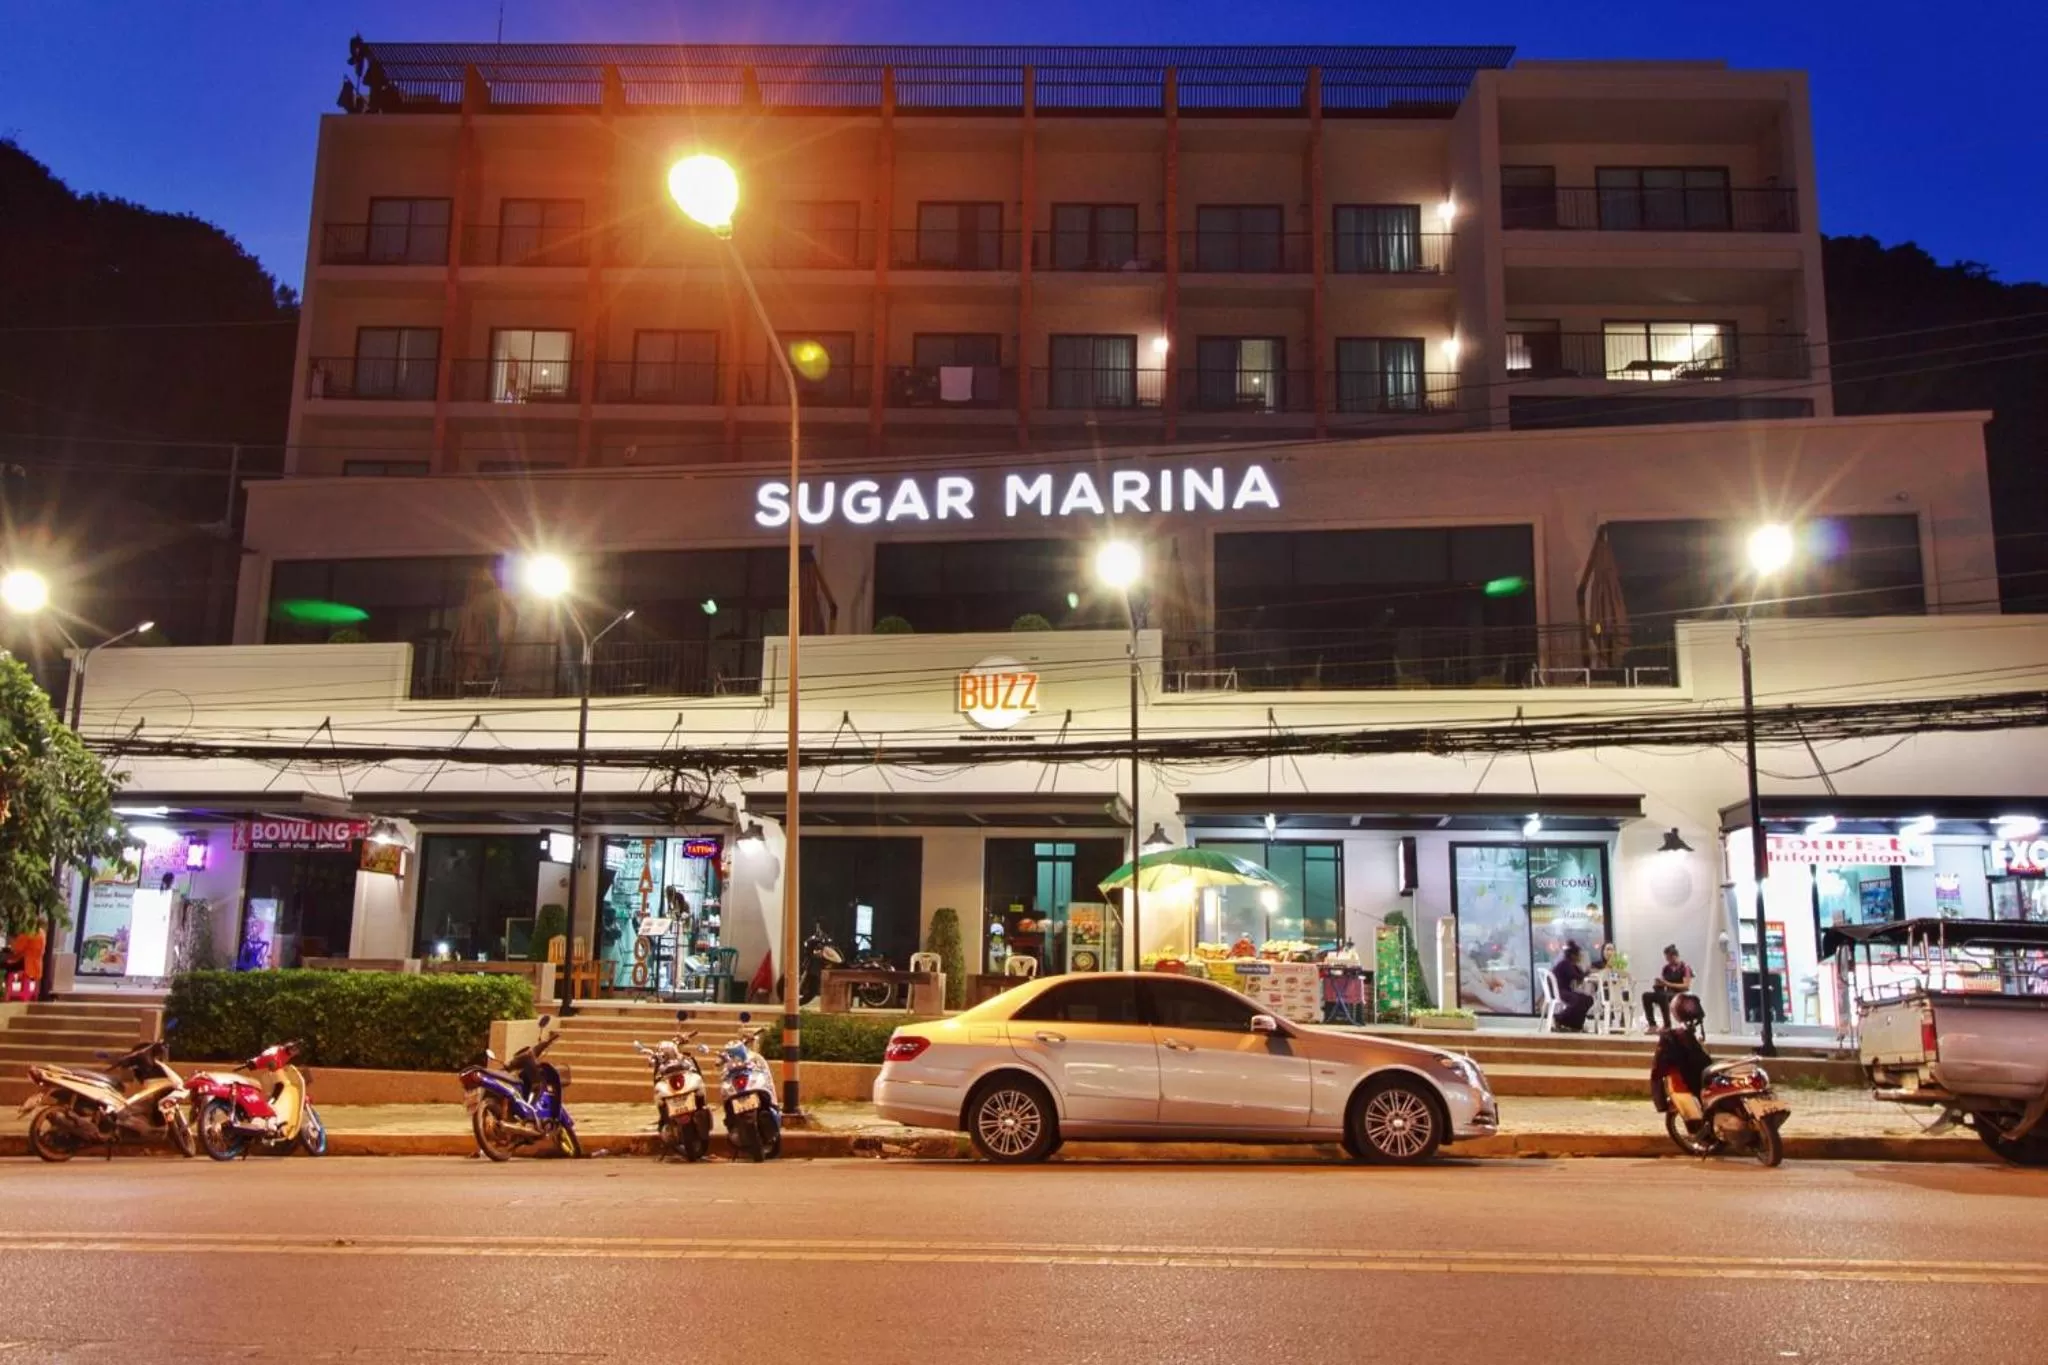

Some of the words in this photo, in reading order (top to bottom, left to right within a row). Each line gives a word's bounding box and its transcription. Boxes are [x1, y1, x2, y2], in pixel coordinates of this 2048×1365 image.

[755, 476, 975, 527] SUGAR
[1004, 465, 1282, 517] MARINA
[959, 672, 1038, 710] BUZZ
[251, 822, 351, 841] BOWLING
[1767, 836, 1902, 852] Tourist
[1767, 851, 1907, 864] Information
